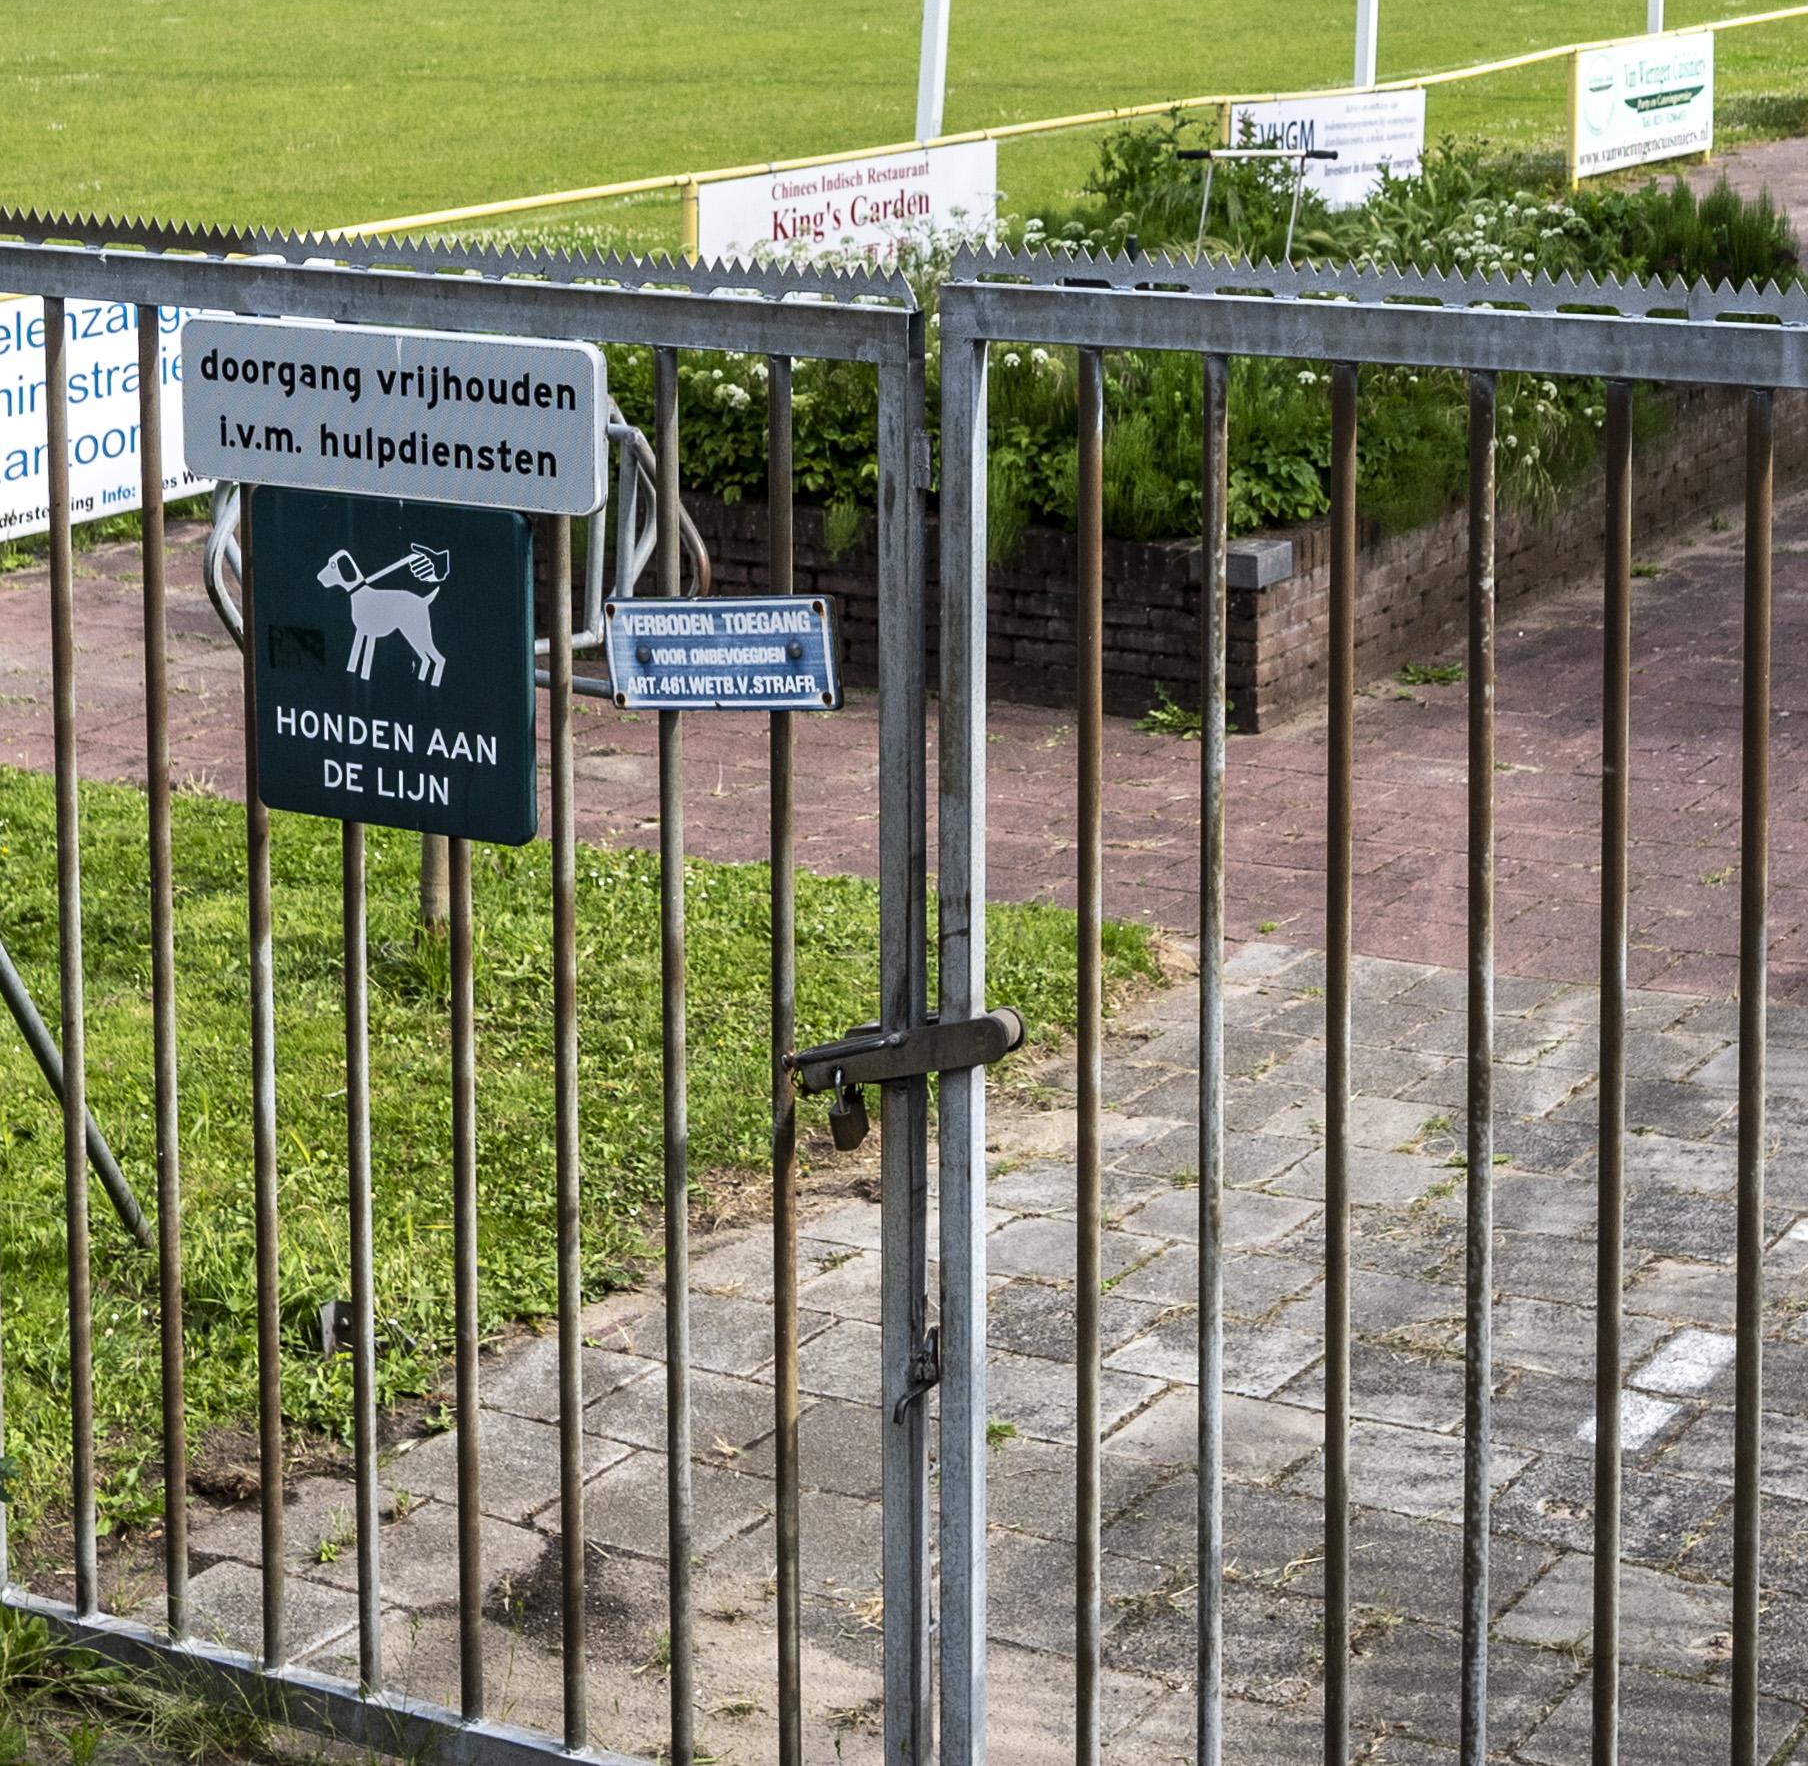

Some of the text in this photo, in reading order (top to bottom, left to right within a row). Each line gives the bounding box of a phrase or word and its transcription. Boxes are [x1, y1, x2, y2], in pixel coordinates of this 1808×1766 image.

[772, 161, 930, 201] Chinees Indisch Restaurant
[772, 188, 930, 244] King's Garden
[199, 347, 577, 410] doorgang vrijhouden
[219, 414, 557, 478] i.v.m. hulpdiensten
[102, 485, 136, 505] Info:
[622, 611, 811, 636] VERBODEN TOEGANG
[651, 646, 786, 665] VOOR ONBEVOEGDEN
[276, 706, 497, 765] HONDEN AAN
[324, 758, 449, 806] DE LIJN
